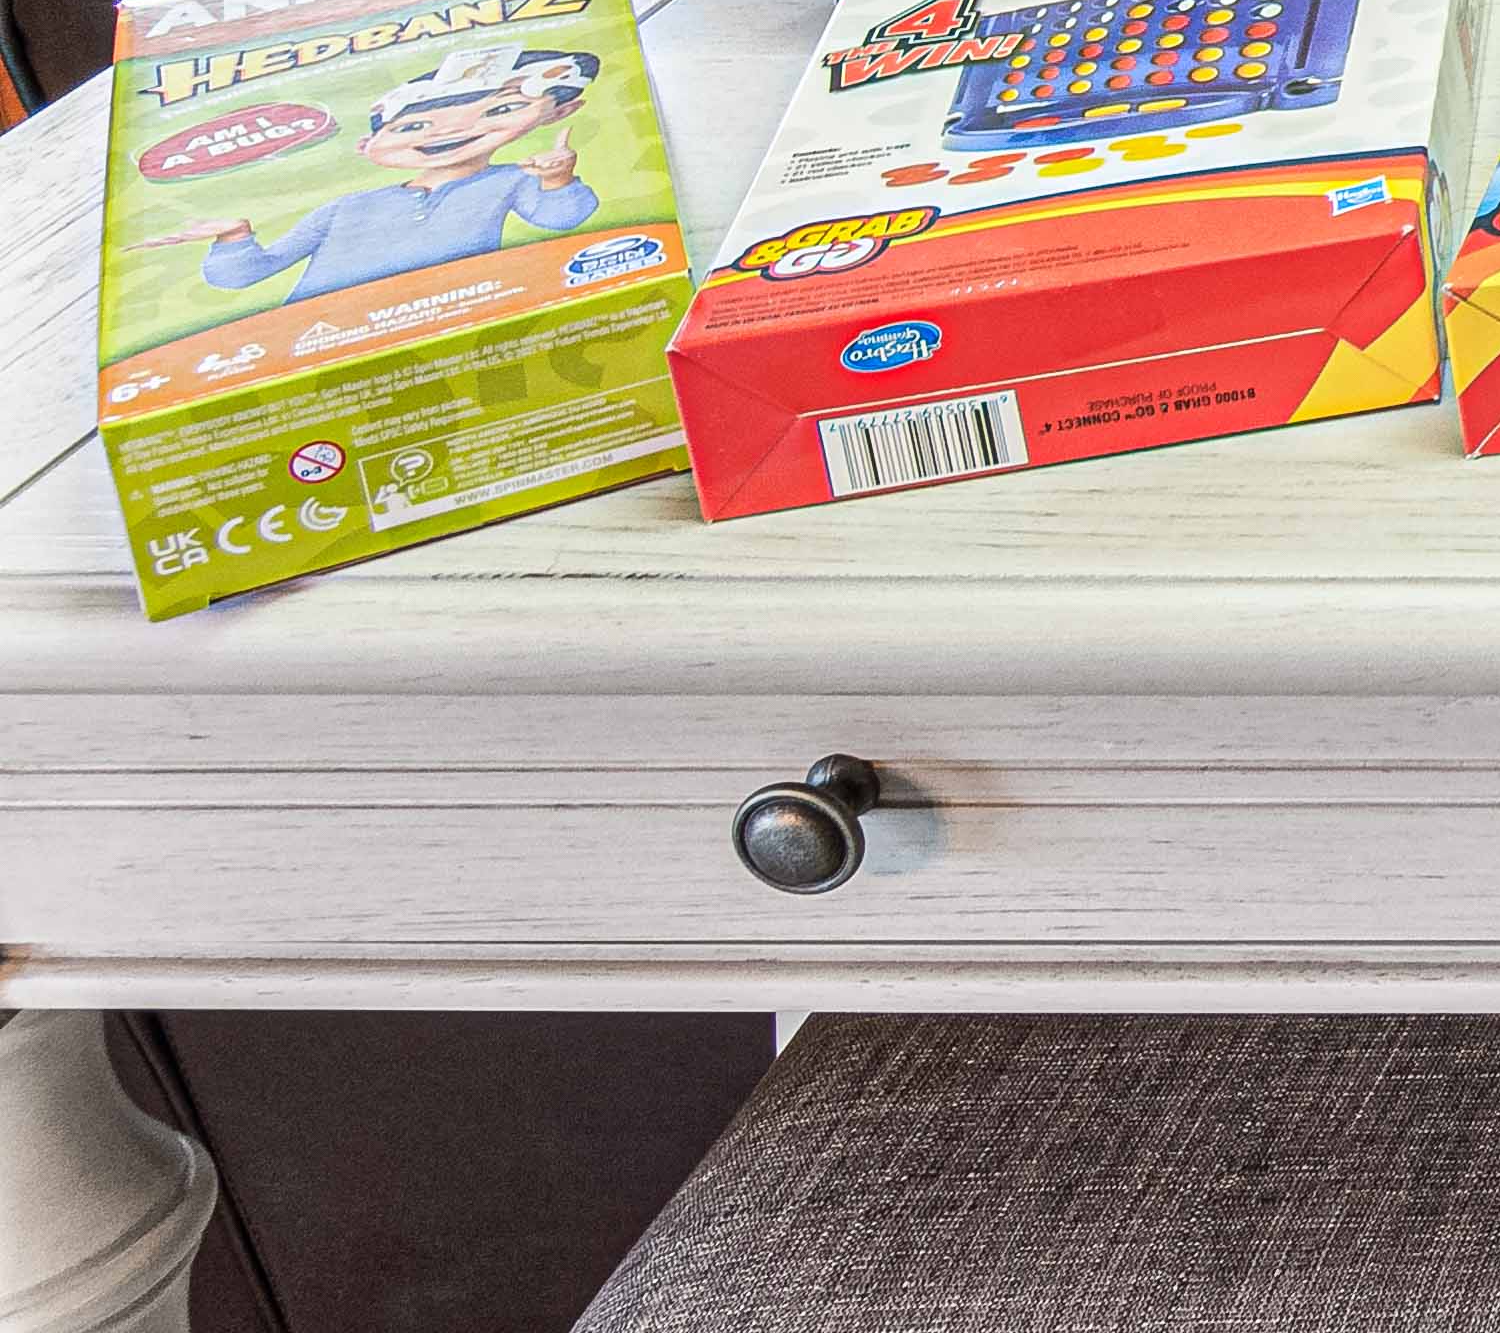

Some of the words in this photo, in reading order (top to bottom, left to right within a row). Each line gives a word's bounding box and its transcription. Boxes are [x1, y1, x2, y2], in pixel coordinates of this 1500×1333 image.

[841, 34, 1024, 88] WIN!
[786, 210, 926, 247] GRAB
[368, 280, 503, 323] WARNING:
